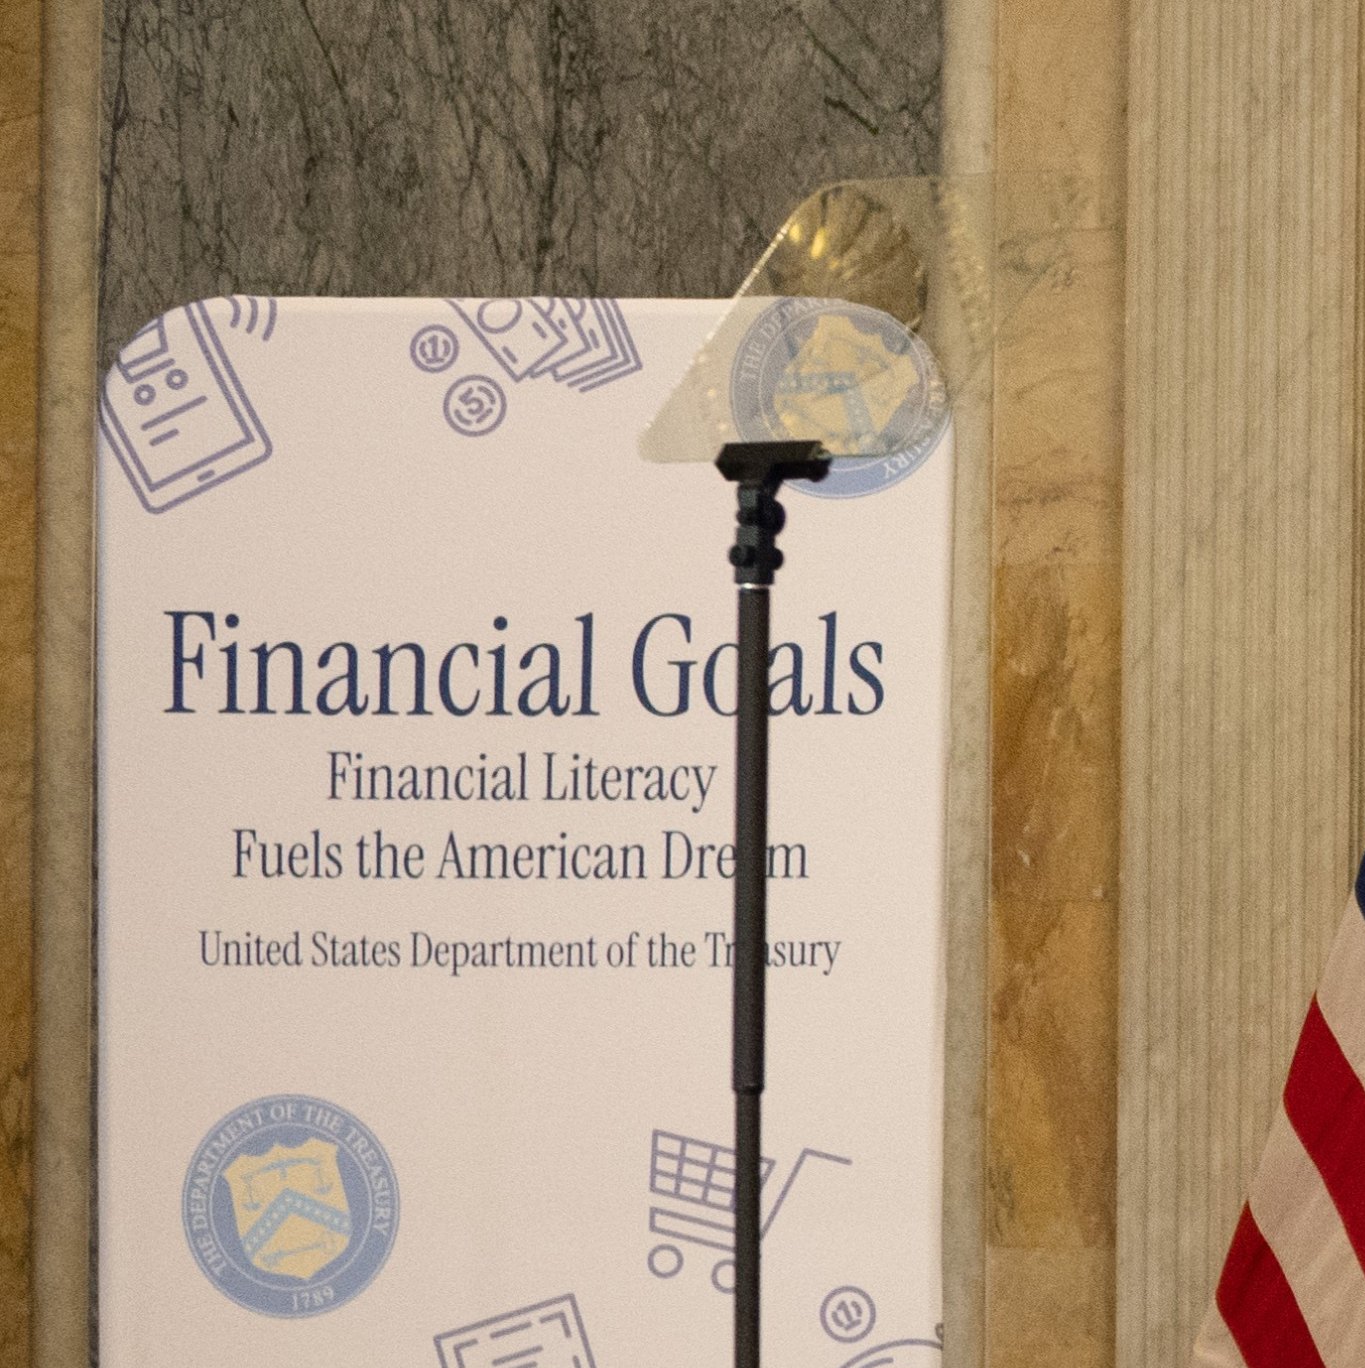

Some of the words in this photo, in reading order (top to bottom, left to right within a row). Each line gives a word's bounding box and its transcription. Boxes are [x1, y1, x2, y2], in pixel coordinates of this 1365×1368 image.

[163, 610, 602, 718] Financial
[328, 751, 530, 802] Financial
[543, 752, 719, 815] Literacy
[233, 828, 345, 880] Fuels
[356, 829, 426, 880] the
[436, 831, 648, 881] American
[662, 830, 810, 881] Drem
[200, 930, 304, 968] United
[311, 931, 402, 969] States
[411, 932, 599, 978] Department
[606, 931, 642, 969] of
[647, 932, 698, 969] the
[705, 932, 843, 978] Trsury
[270, 1103, 297, 1122] OF
[306, 1104, 344, 1133] THE
[190, 1109, 265, 1232] DEPARTMENT
[346, 1127, 392, 1237] TREASURY
[196, 1235, 228, 1277] THE
[290, 1286, 336, 1311] 1789
